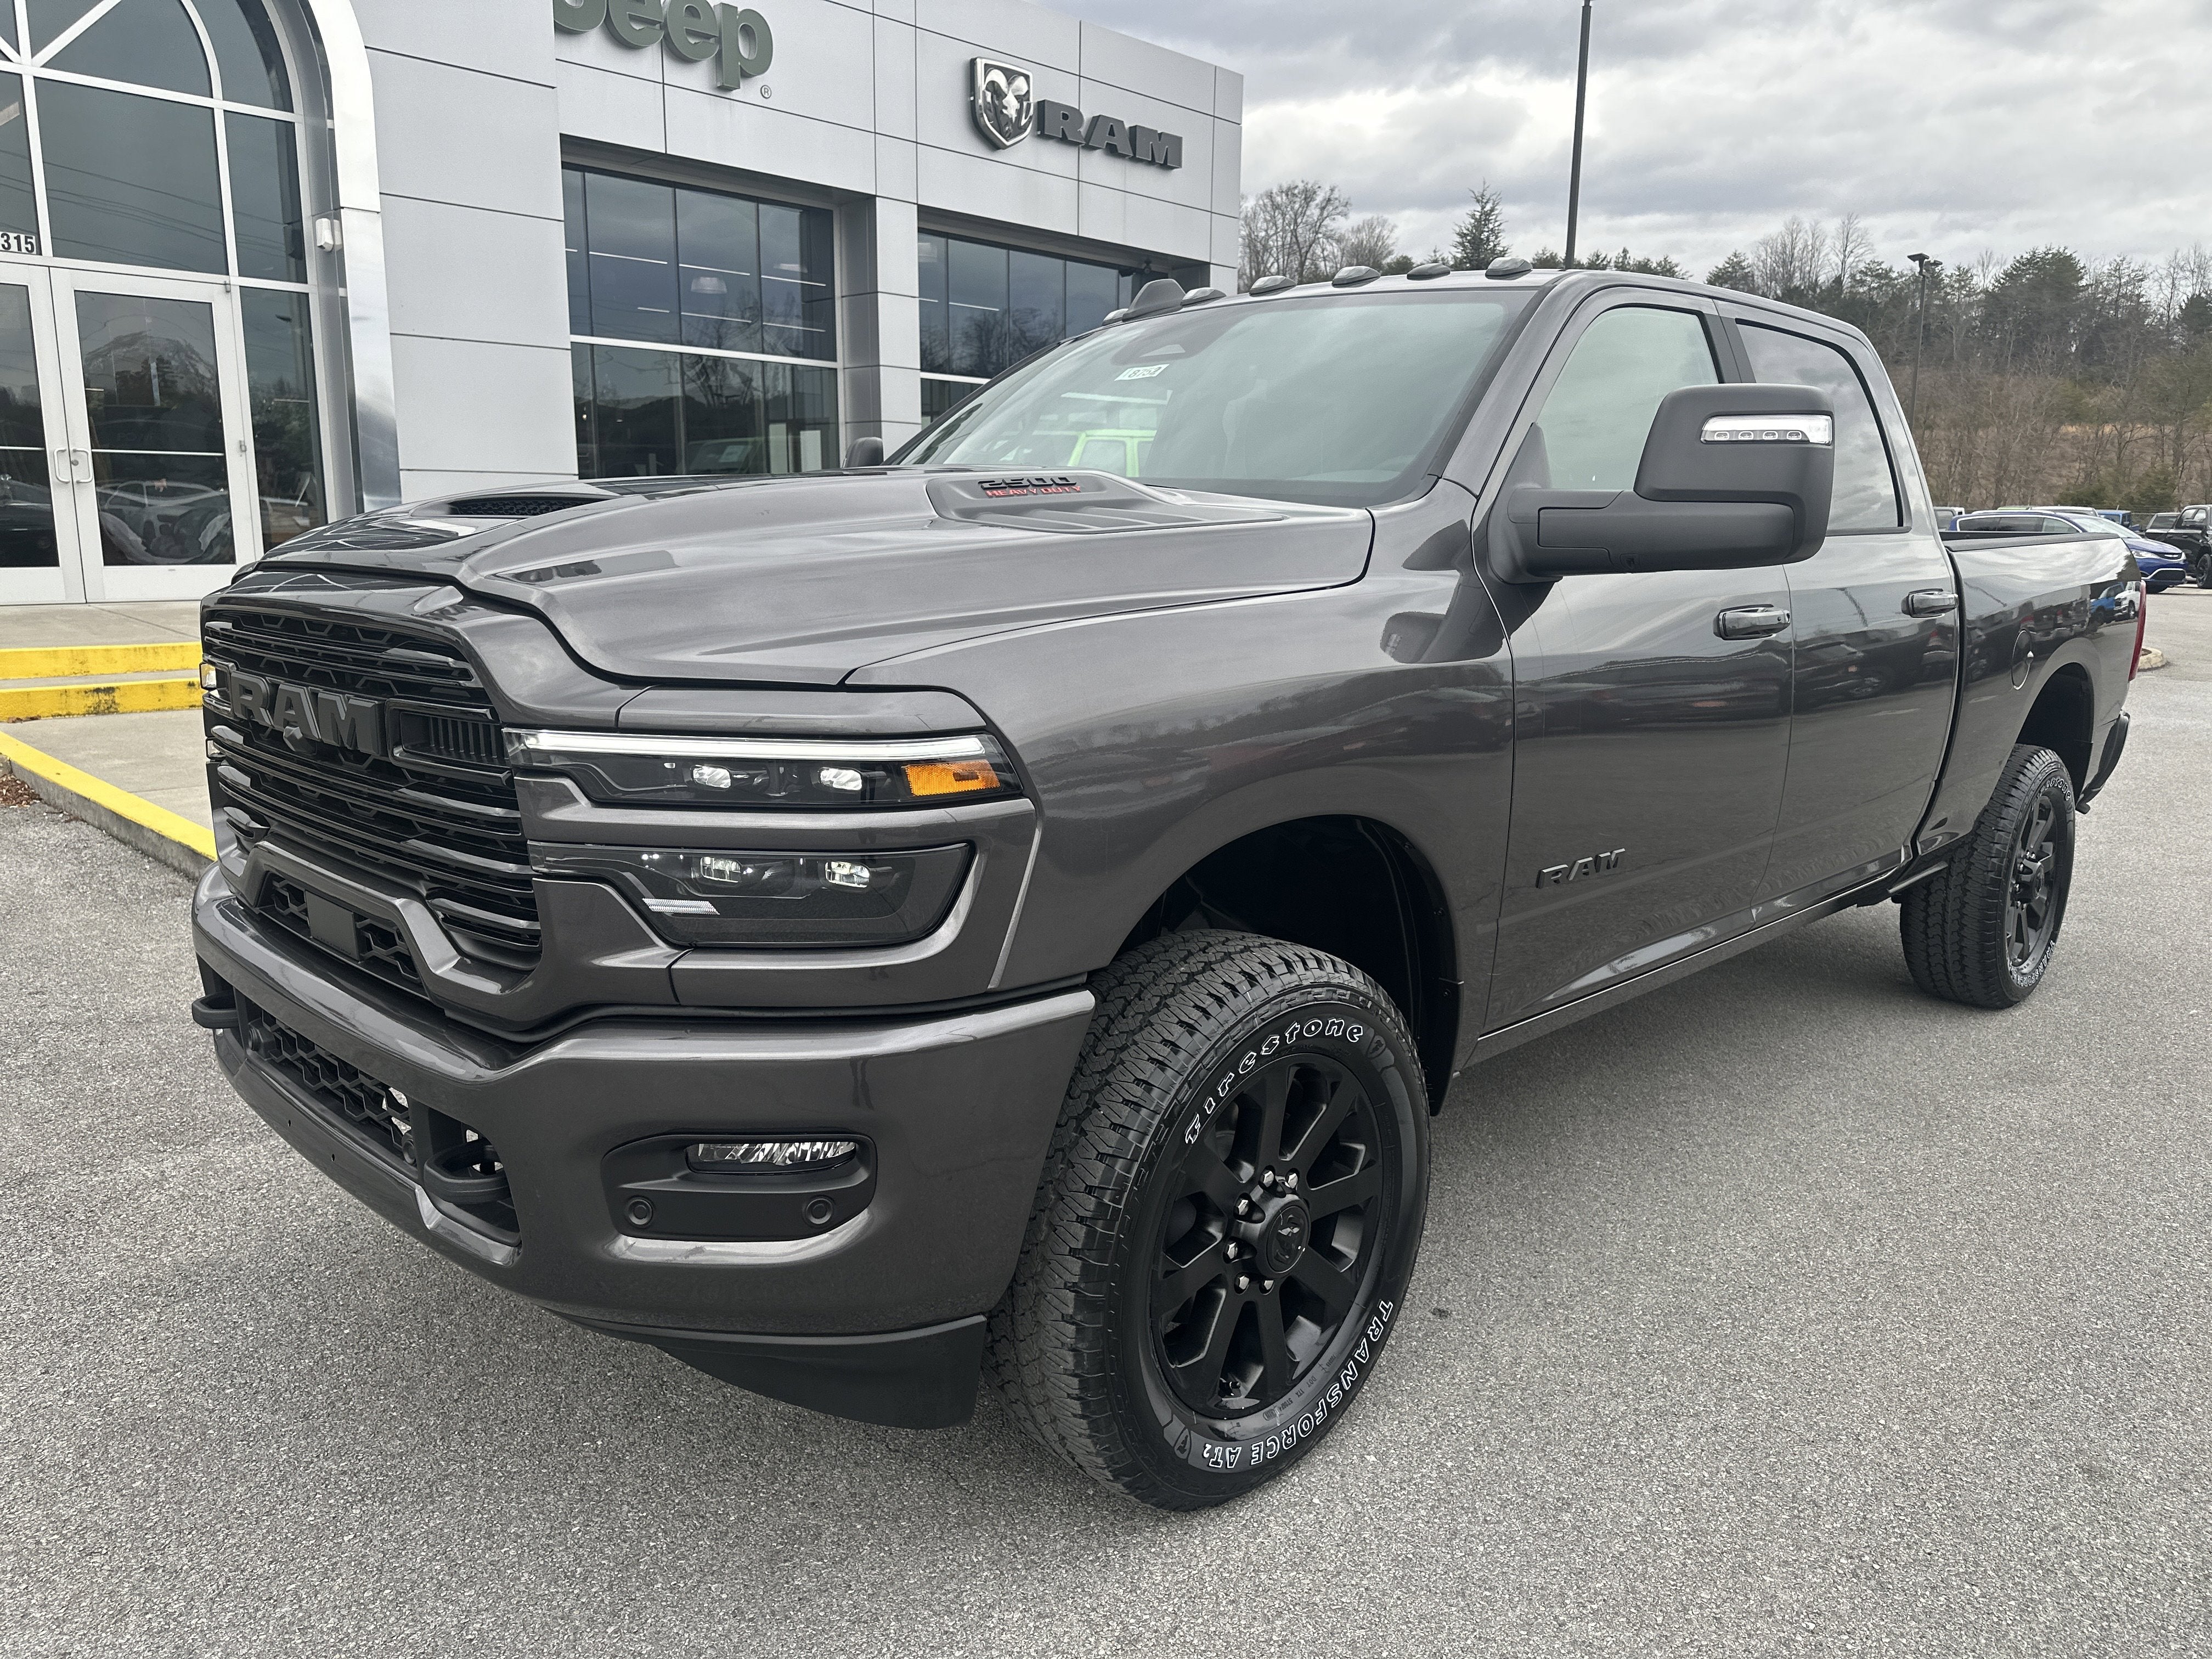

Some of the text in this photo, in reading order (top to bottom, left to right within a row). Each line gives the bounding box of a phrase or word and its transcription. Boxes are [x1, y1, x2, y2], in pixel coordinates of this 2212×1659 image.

[1037, 99, 1183, 169] RAM
[1, 233, 35, 253] 315
[978, 477, 1077, 490] 2500
[985, 488, 1037, 498] HEAVY
[230, 670, 381, 755] RAM
[1536, 848, 1626, 889] RAM
[1185, 1017, 1364, 1144] Firestone
[1203, 1299, 1393, 1469] TRANSFORCE AT2
